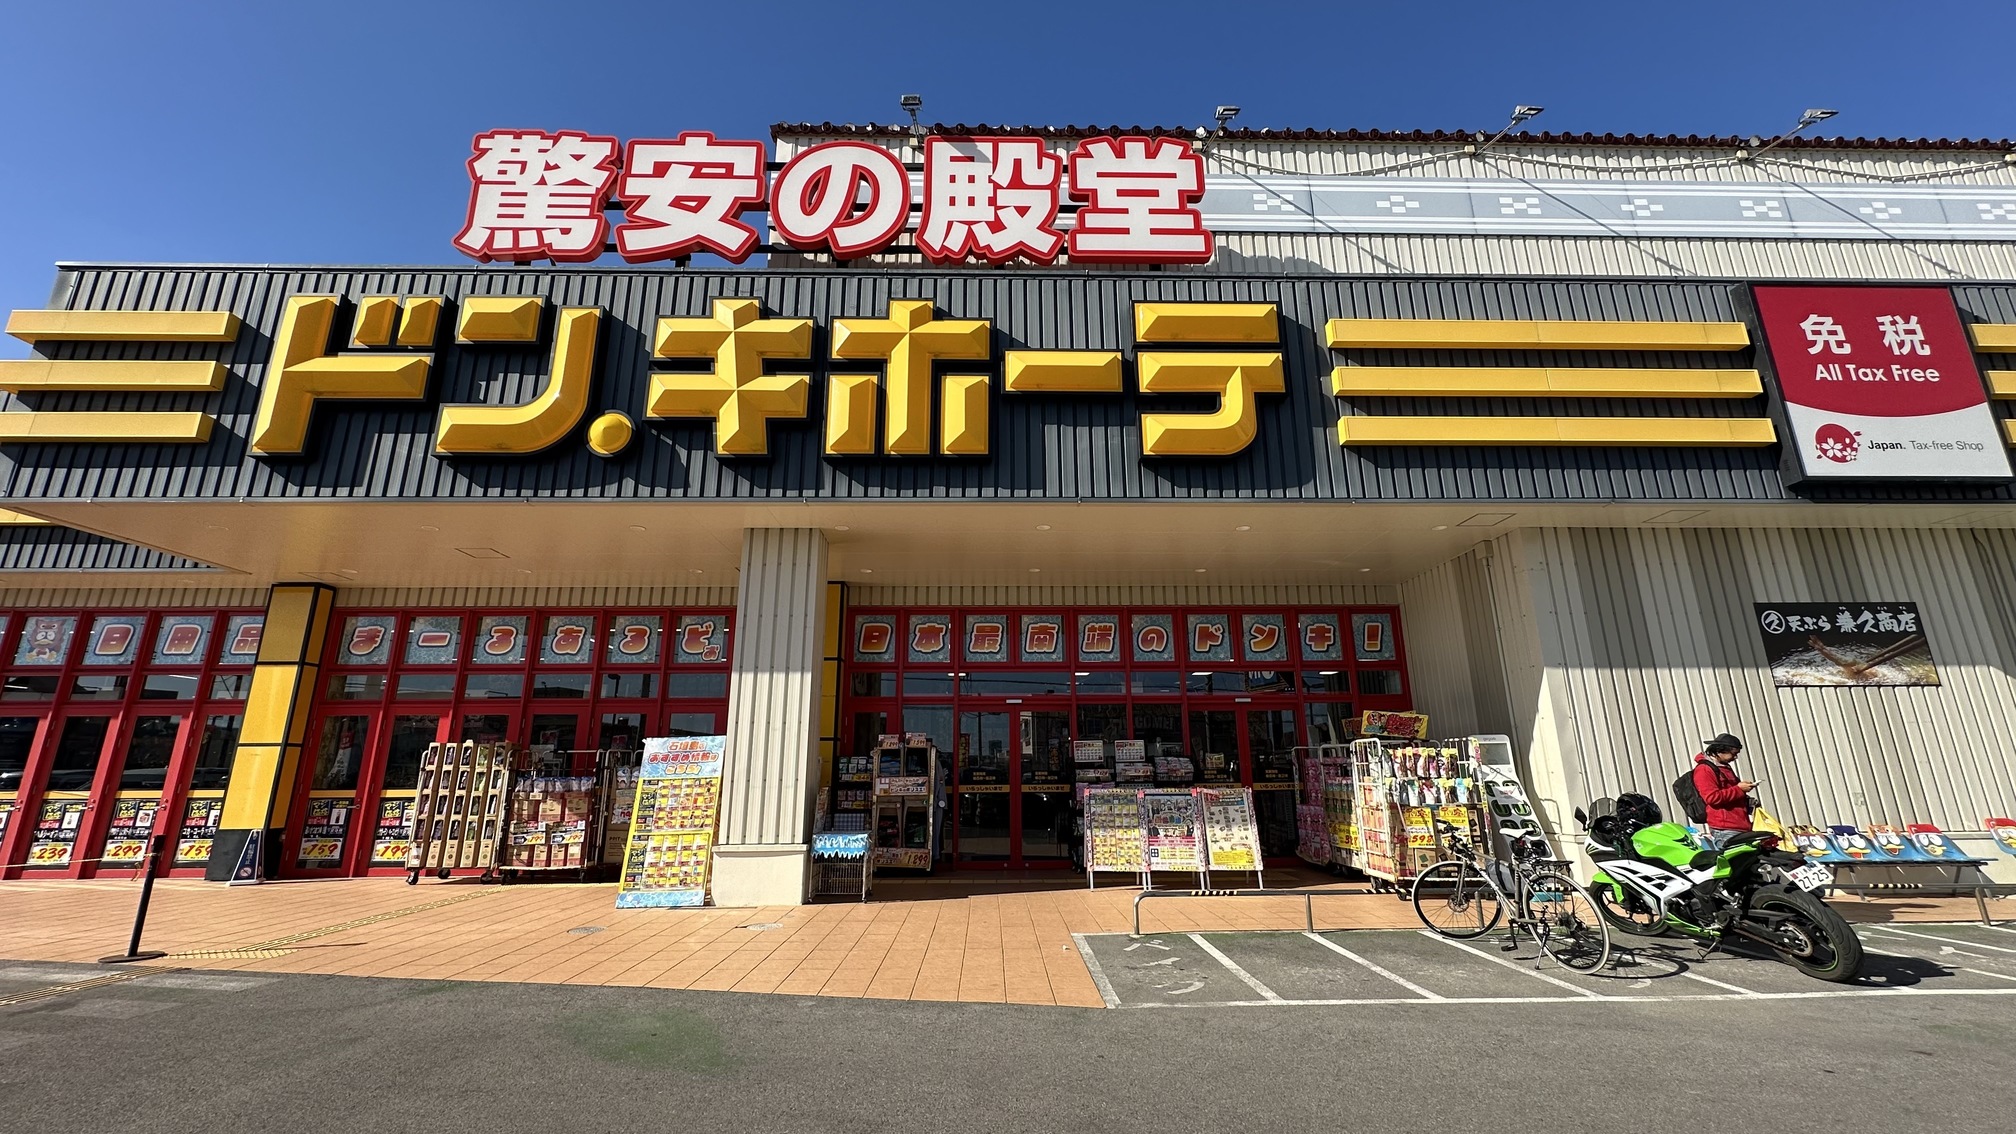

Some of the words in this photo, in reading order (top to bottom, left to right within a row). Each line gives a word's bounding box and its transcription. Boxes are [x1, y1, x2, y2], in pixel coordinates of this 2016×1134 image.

[452, 129, 1214, 265] 驚安の殿堂
[1799, 314, 1931, 356] 免税
[1815, 363, 1843, 381] All
[1845, 364, 1887, 382] Tax
[1892, 364, 1941, 382] Free
[1867, 440, 1907, 452] Japan.
[1909, 440, 1954, 451] Tax-free
[1956, 440, 1984, 453] Shop
[1835, 610, 1918, 634] 兼久商店
[36, 847, 68, 860] 239
[111, 845, 143, 857] 299
[307, 843, 338, 856] 159
